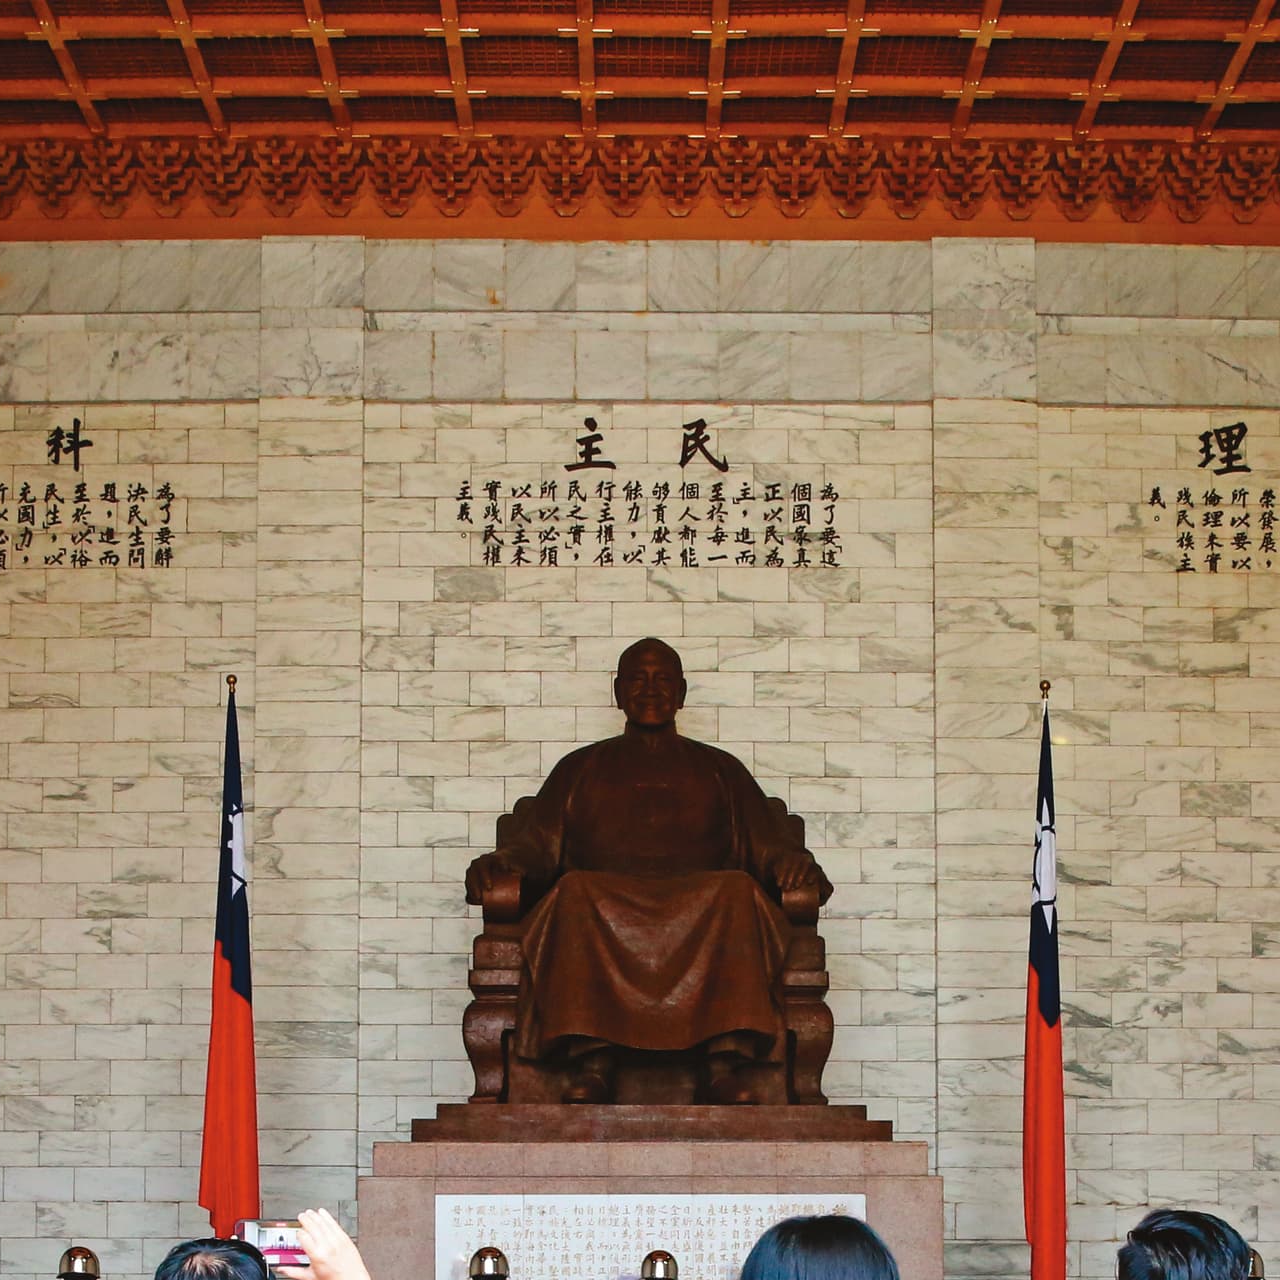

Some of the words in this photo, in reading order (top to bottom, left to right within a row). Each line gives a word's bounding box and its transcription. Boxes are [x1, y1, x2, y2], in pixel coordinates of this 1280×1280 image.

[127, 482, 149, 570] 決民生問
[455, 480, 474, 539] 主義。
[482, 480, 506, 568] 實踐民權
[510, 483, 532, 567] 以民主來
[538, 480, 561, 568] 所以必須
[593, 480, 617, 568] 行主權在
[678, 481, 701, 568] 個人都能
[706, 481, 729, 562] 至於每一
[763, 482, 785, 568] 正以民為
[790, 482, 812, 569] 個國家真
[1147, 486, 1167, 523] 義。
[1175, 487, 1197, 574] 踐民族主
[1201, 488, 1224, 574] 倫理來實
[1229, 487, 1252, 570] 所以要以
